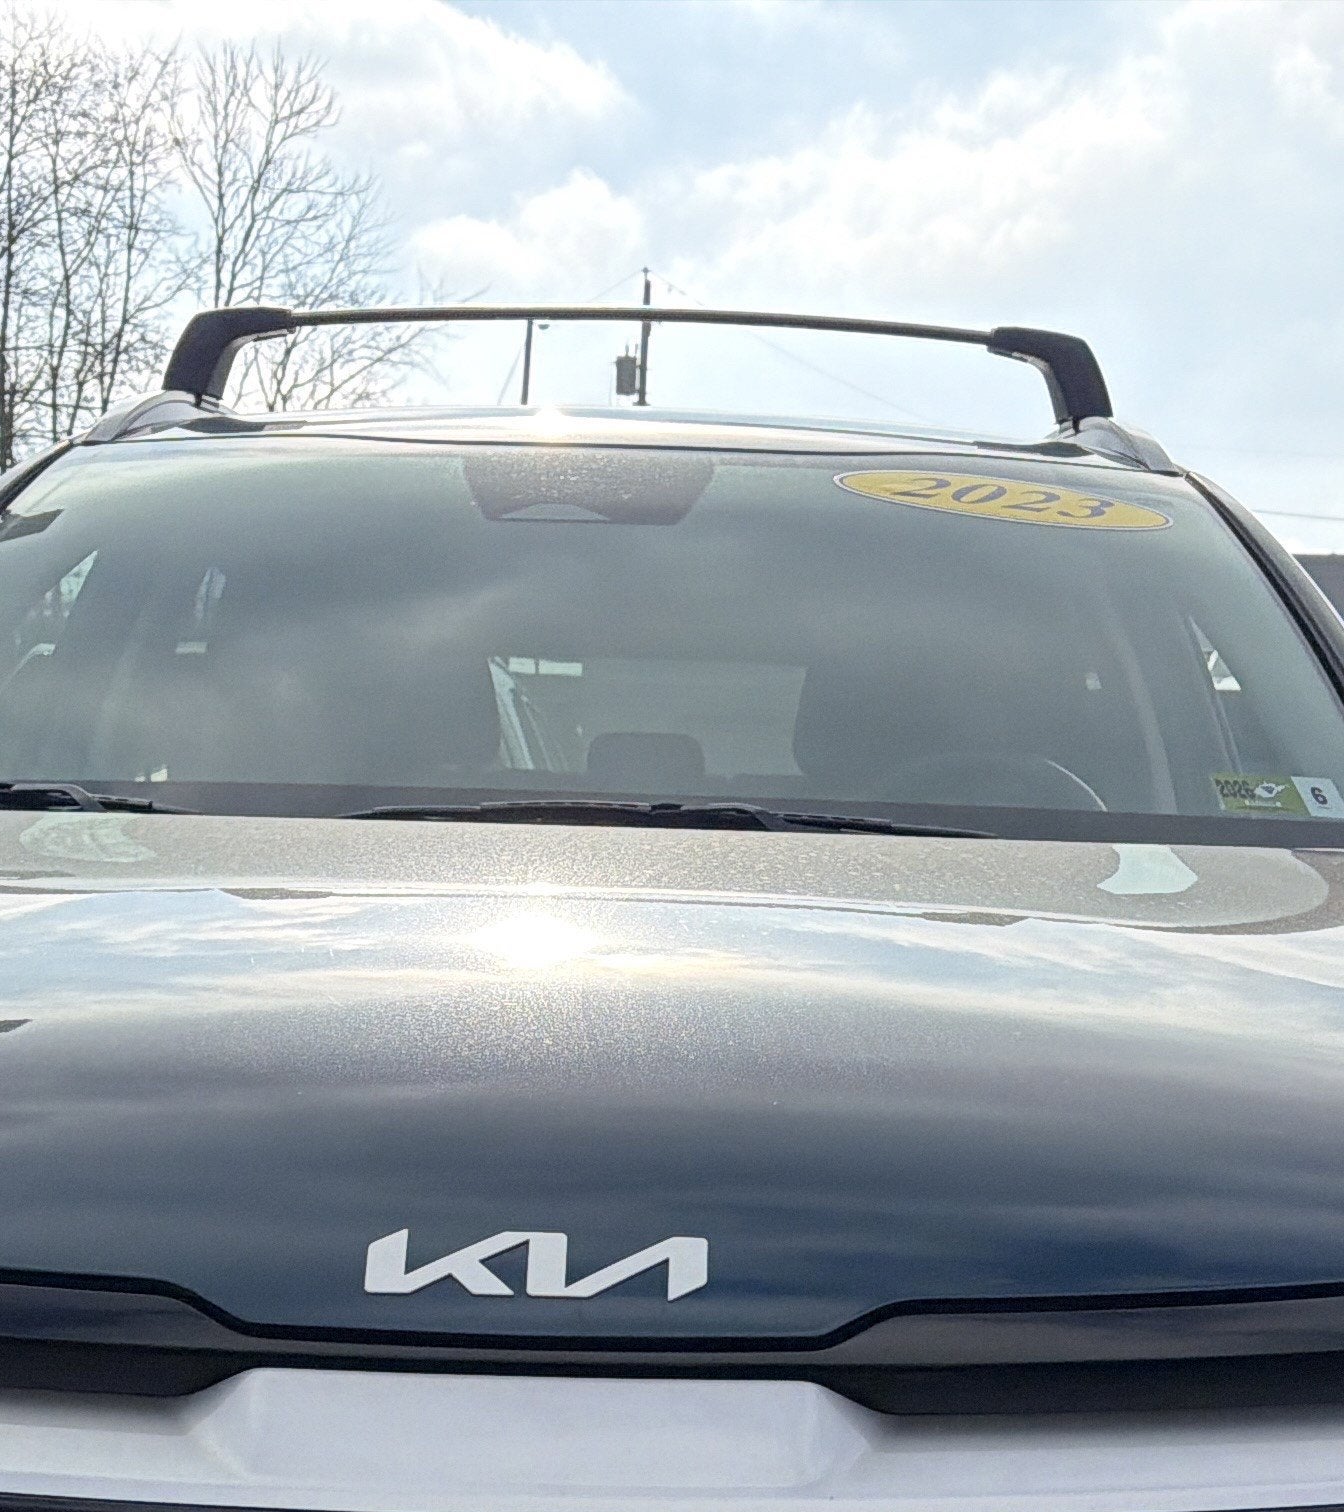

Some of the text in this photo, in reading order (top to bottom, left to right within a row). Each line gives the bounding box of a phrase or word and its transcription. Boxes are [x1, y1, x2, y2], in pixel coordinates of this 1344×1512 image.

[891, 477, 1116, 520] 2023
[1310, 786, 1328, 805] 6
[364, 1228, 708, 1302] KIA
